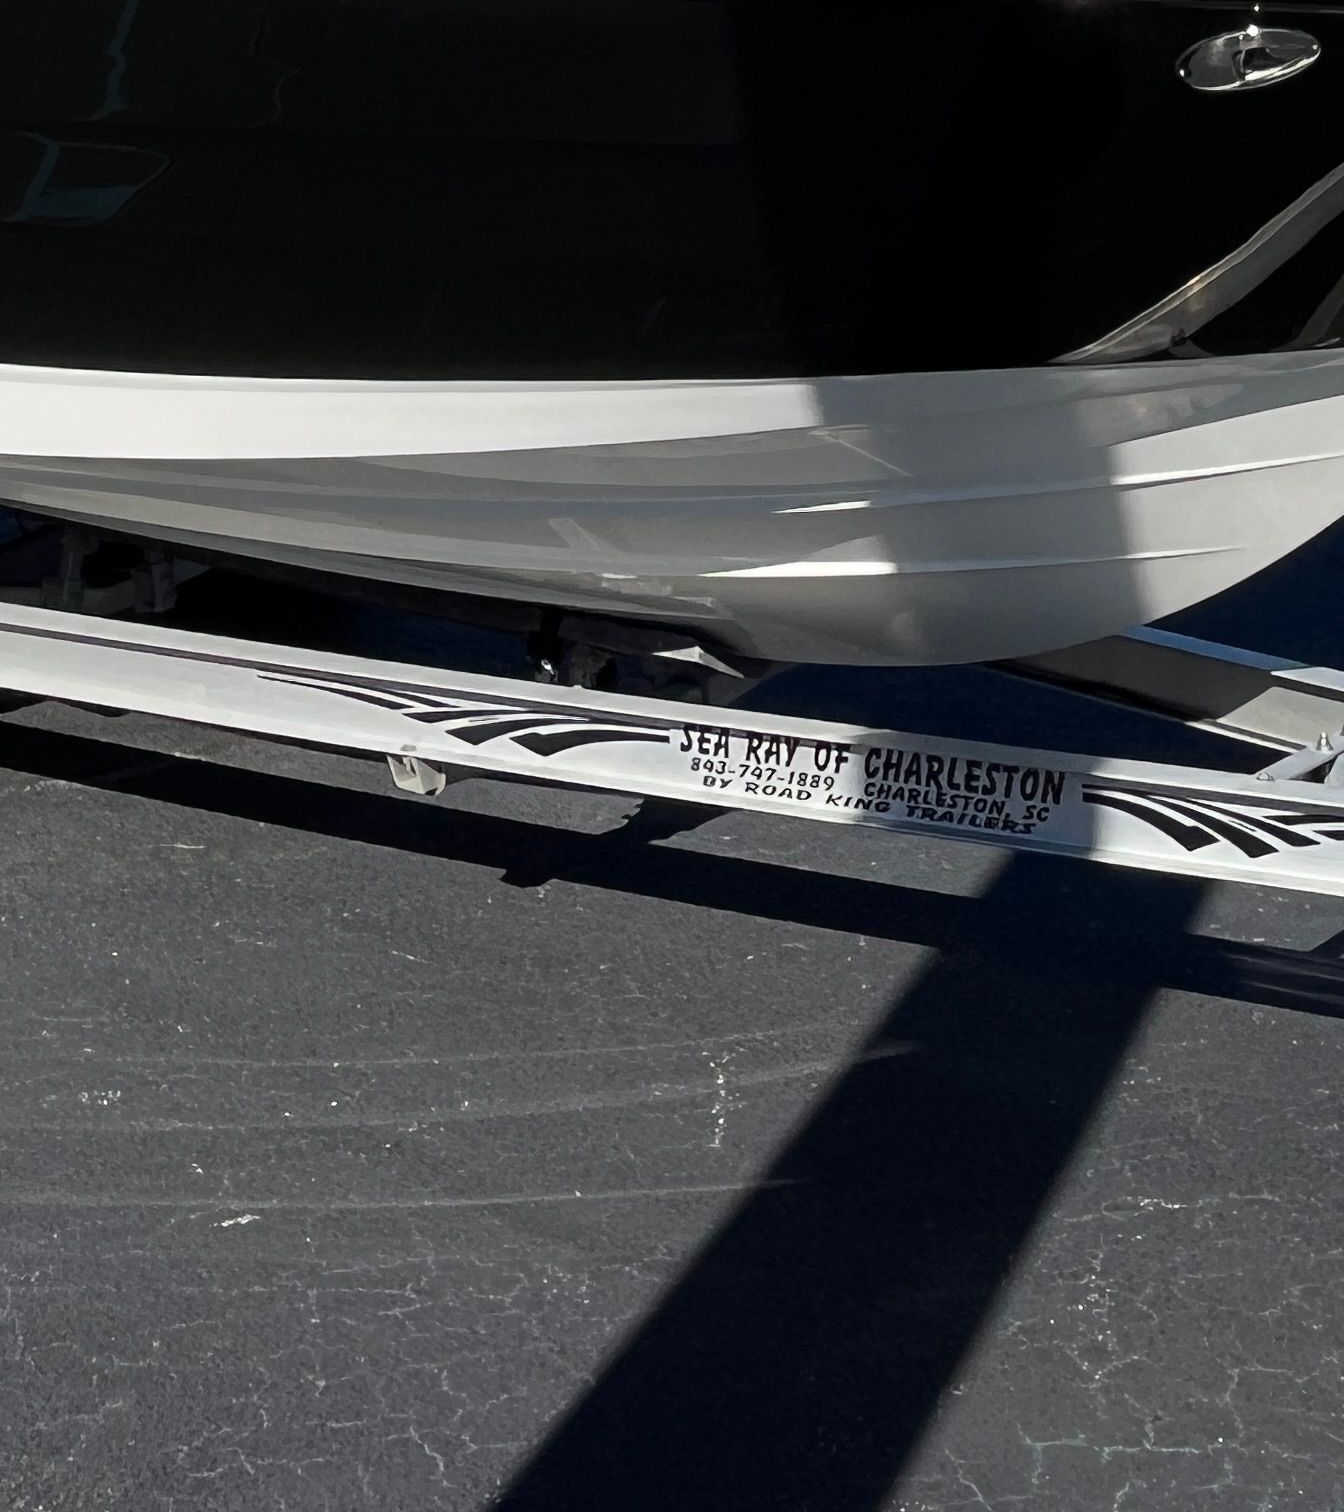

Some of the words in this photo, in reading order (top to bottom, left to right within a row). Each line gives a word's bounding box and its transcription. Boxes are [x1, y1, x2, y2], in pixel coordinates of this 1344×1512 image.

[680, 724, 730, 759] SEA
[745, 731, 800, 767] RAY
[814, 740, 852, 774] OF
[864, 747, 1066, 805] CHARLESTON
[702, 775, 733, 789] BY
[744, 781, 812, 801] ROAD
[825, 793, 891, 813] KING
[905, 804, 1038, 834] TRAILERS
[863, 782, 1011, 819] CHARLESTON,
[1022, 804, 1050, 822] SC
